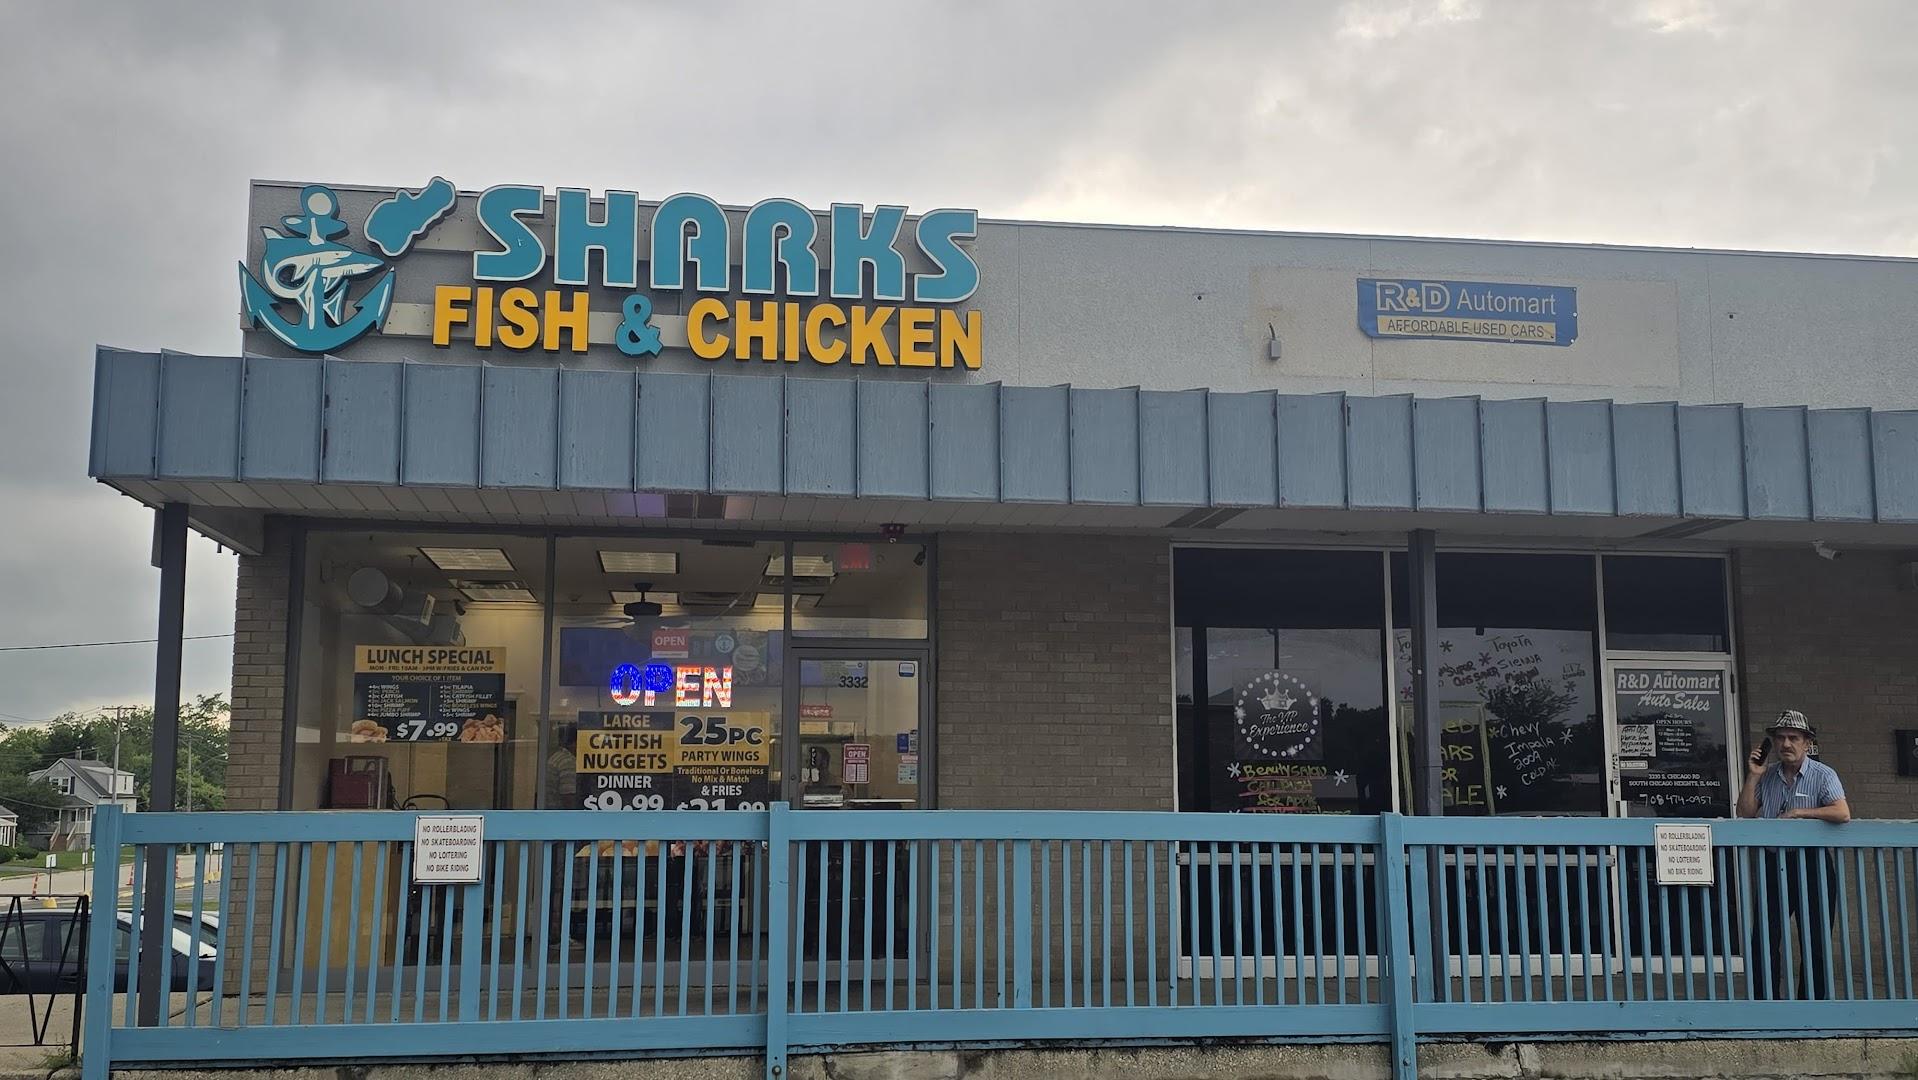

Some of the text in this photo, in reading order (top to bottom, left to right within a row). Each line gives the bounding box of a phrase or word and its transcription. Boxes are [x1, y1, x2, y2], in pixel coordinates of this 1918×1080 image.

[472, 183, 982, 303] SHARKS
[1376, 281, 1556, 315] R&D Automart
[432, 285, 983, 370] FISH & CHICKEN
[1387, 319, 1545, 338] AFFORDABLE USED CARS
[655, 636, 686, 646] OPEN
[367, 649, 494, 665] LUNCH SPECIAL
[609, 662, 734, 708] OPEN
[839, 676, 868, 688] 3332
[1617, 674, 1720, 689] R&D Automart
[1638, 689, 1710, 712] Auto Sales
[603, 714, 650, 728] LARGE
[1259, 713, 1277, 724] The
[396, 720, 458, 741] $7.99
[680, 716, 762, 746] 25PC
[1250, 722, 1309, 741] Experience
[1500, 721, 1540, 737] Chevy
[589, 734, 662, 750] CATFISH
[681, 751, 759, 762] PARTY WINGS
[848, 750, 866, 758] OPEN
[1441, 745, 1475, 761] ARS
[583, 753, 667, 770] NUGGETS
[678, 767, 764, 775] Traditional Or Boneless
[1441, 767, 1458, 782] OR
[598, 776, 652, 789] DINNER
[702, 786, 742, 796] & FRIES
[1442, 784, 1485, 806] ALE
[1640, 794, 1712, 806] 708 474-0957
[422, 825, 477, 833] NO ROLLERBLADING
[1660, 832, 1706, 840] NO ROLLERBLADING
[421, 838, 476, 846] NO SKATEBOARDING
[1669, 844, 1707, 852] SKATEBOARDING
[429, 851, 468, 859] NO LOITERING
[426, 864, 469, 872] NO BIKE RIDING
